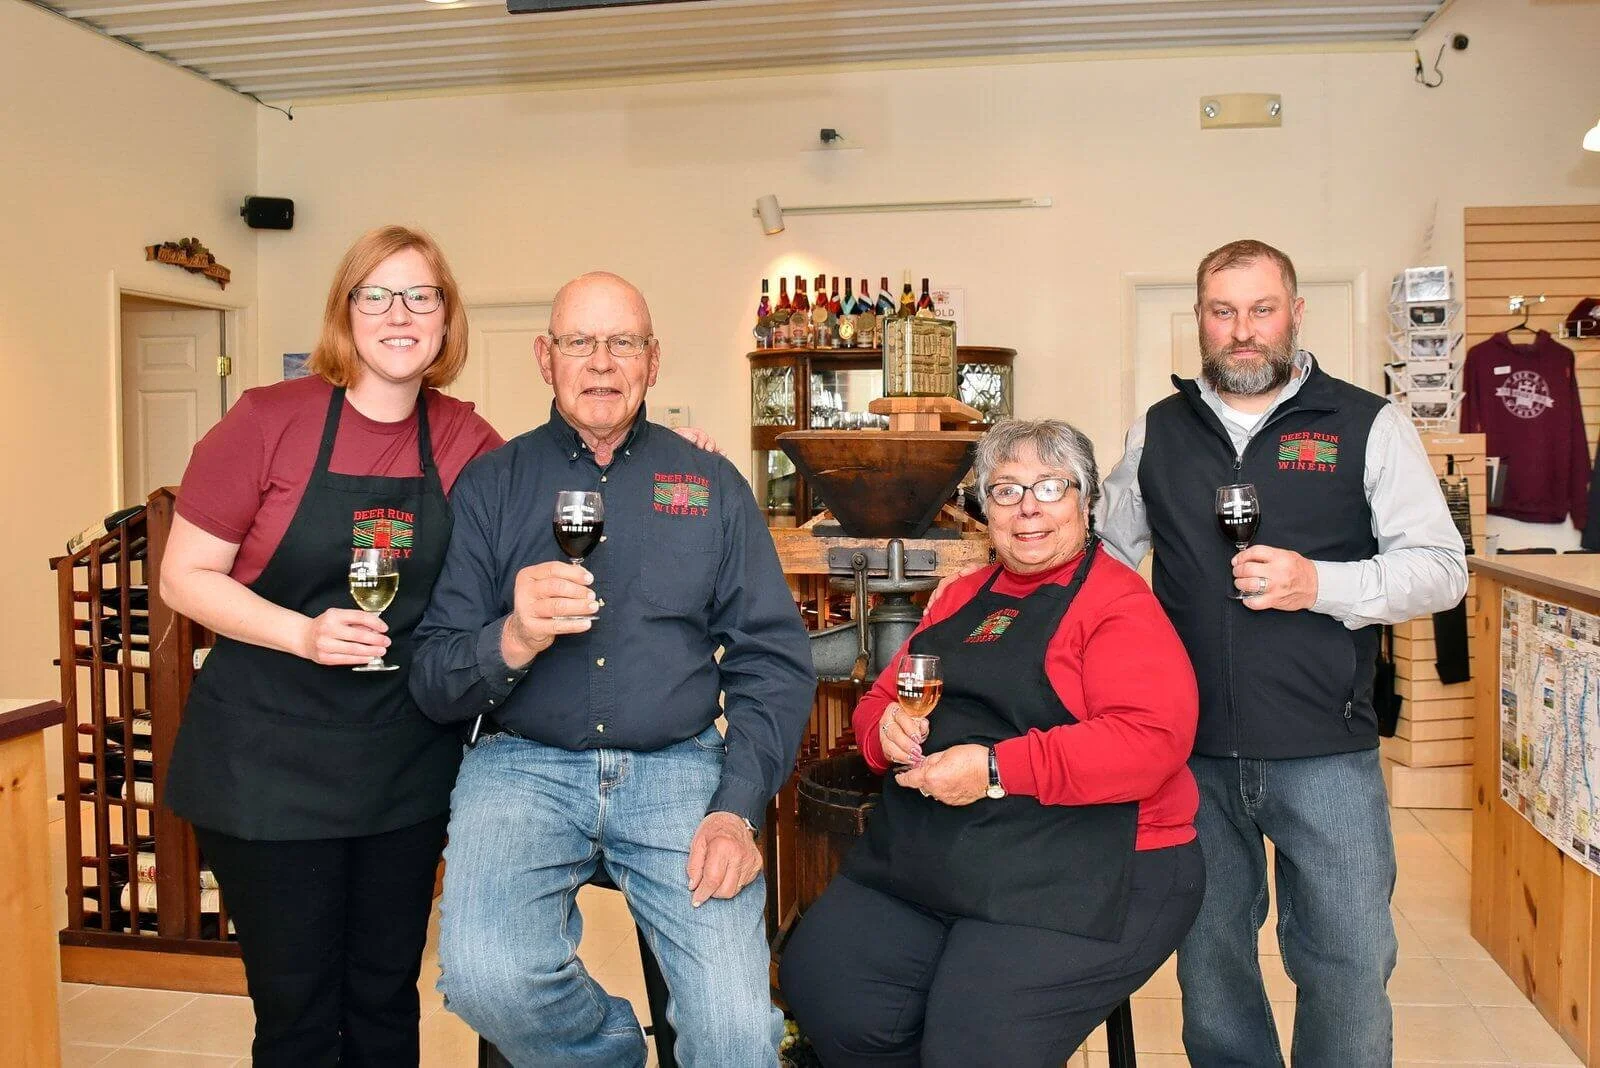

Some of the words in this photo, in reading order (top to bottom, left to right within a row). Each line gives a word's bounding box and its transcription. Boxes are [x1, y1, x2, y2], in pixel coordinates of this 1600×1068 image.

[934, 309, 955, 317] OLD
[1280, 432, 1311, 442] DEER
[1313, 432, 1339, 444] RUN
[1278, 461, 1337, 473] WINERY
[654, 472, 682, 483] DEER
[686, 474, 709, 488] RUN
[353, 508, 385, 520] DEER
[388, 508, 415, 522] RUN
[653, 502, 709, 517] WINERY
